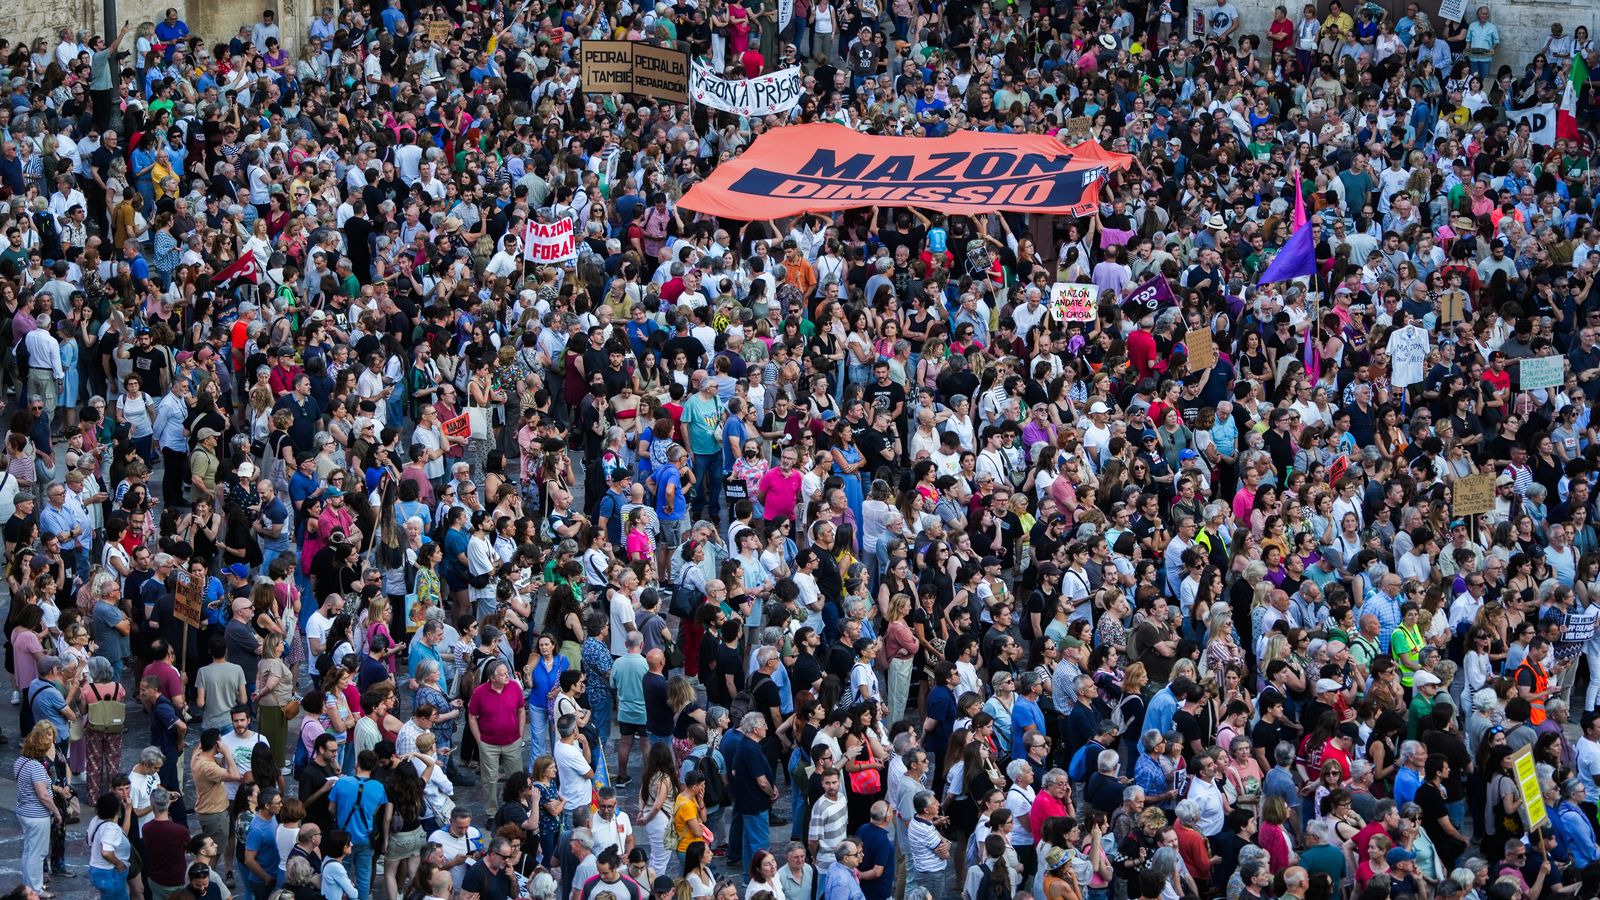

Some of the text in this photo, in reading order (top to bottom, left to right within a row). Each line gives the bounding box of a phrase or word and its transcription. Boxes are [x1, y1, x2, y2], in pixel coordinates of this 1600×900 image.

[586, 51, 631, 64] PEDRAL
[636, 55, 686, 76] PEDRALBA
[636, 76, 686, 94] REPARACIÓN
[740, 83, 748, 107] A
[769, 175, 1056, 204] DIMISSIÓ
[532, 235, 574, 260] FORA!
[1060, 288, 1090, 298] MAZÓN
[1086, 300, 1092, 308] A
